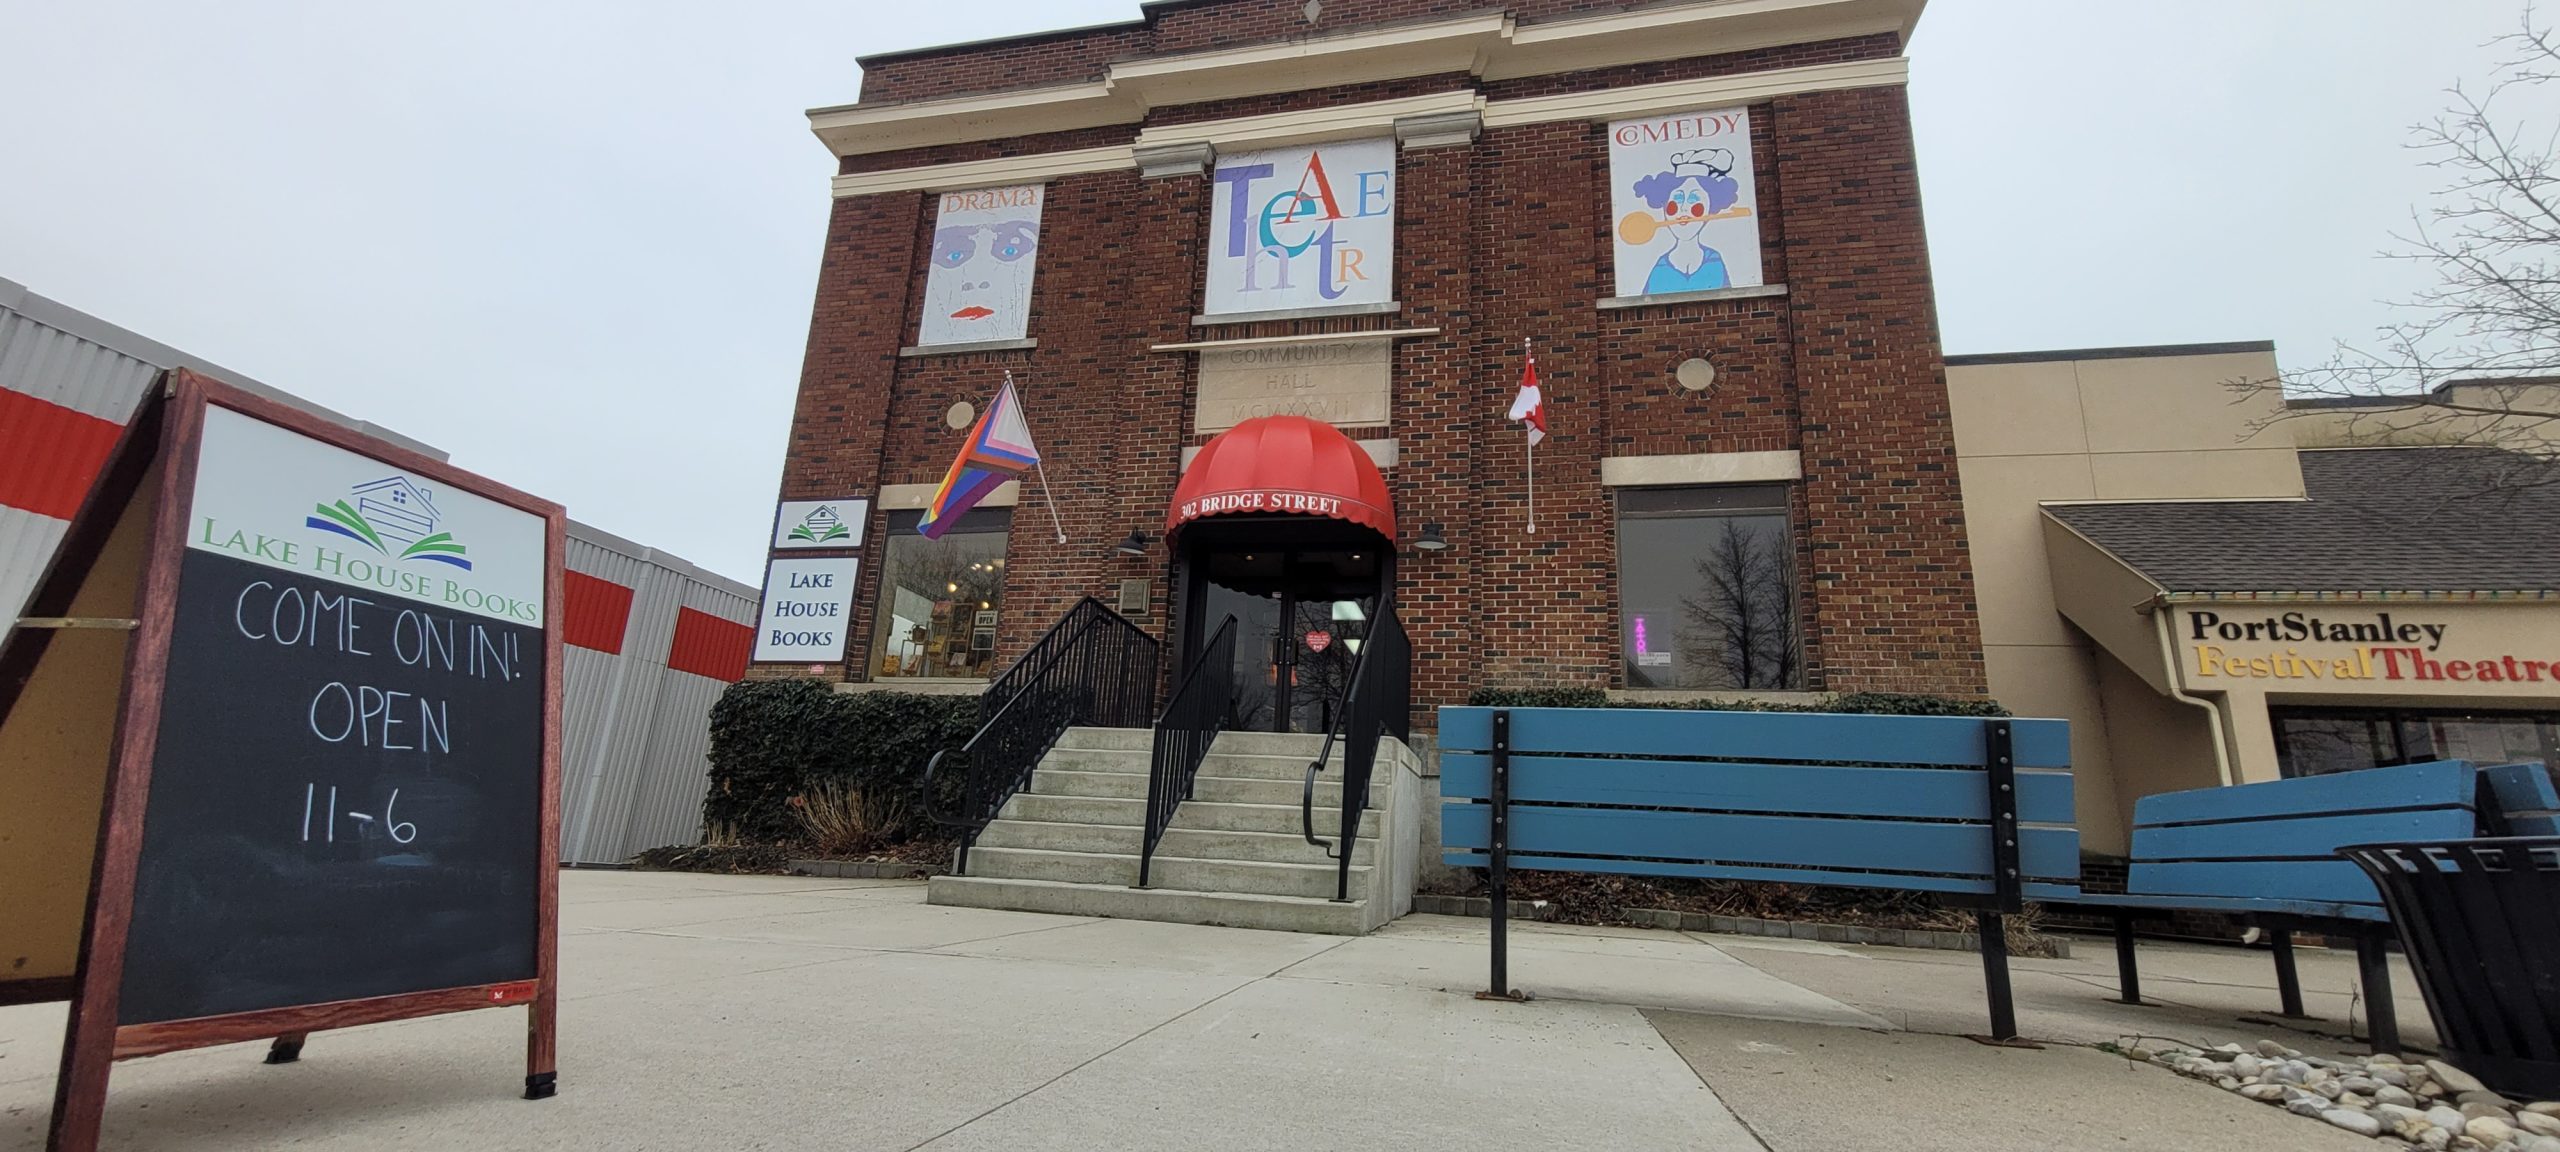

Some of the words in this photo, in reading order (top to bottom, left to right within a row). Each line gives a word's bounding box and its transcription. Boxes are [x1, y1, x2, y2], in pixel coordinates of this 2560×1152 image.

[1615, 113, 1743, 147] COMEDY
[1230, 342, 1357, 364] COMMUNITY
[1266, 373, 1318, 390] HALL
[1180, 502, 1197, 520] 302
[1201, 493, 1265, 513] BRIDGE
[1271, 493, 1341, 514] STREET
[201, 517, 299, 565] LAKE
[314, 546, 431, 597] HOUSE
[444, 578, 537, 622] BOOKS
[789, 572, 834, 588] LAKE
[774, 600, 839, 617] HOUSE
[236, 581, 375, 655] COME
[394, 608, 453, 671] ON
[469, 623, 521, 681] IN!
[770, 629, 833, 646] BOOKS
[2187, 610, 2447, 651] PortStanley
[311, 682, 449, 754] OPEN
[303, 783, 416, 843] 11-6
